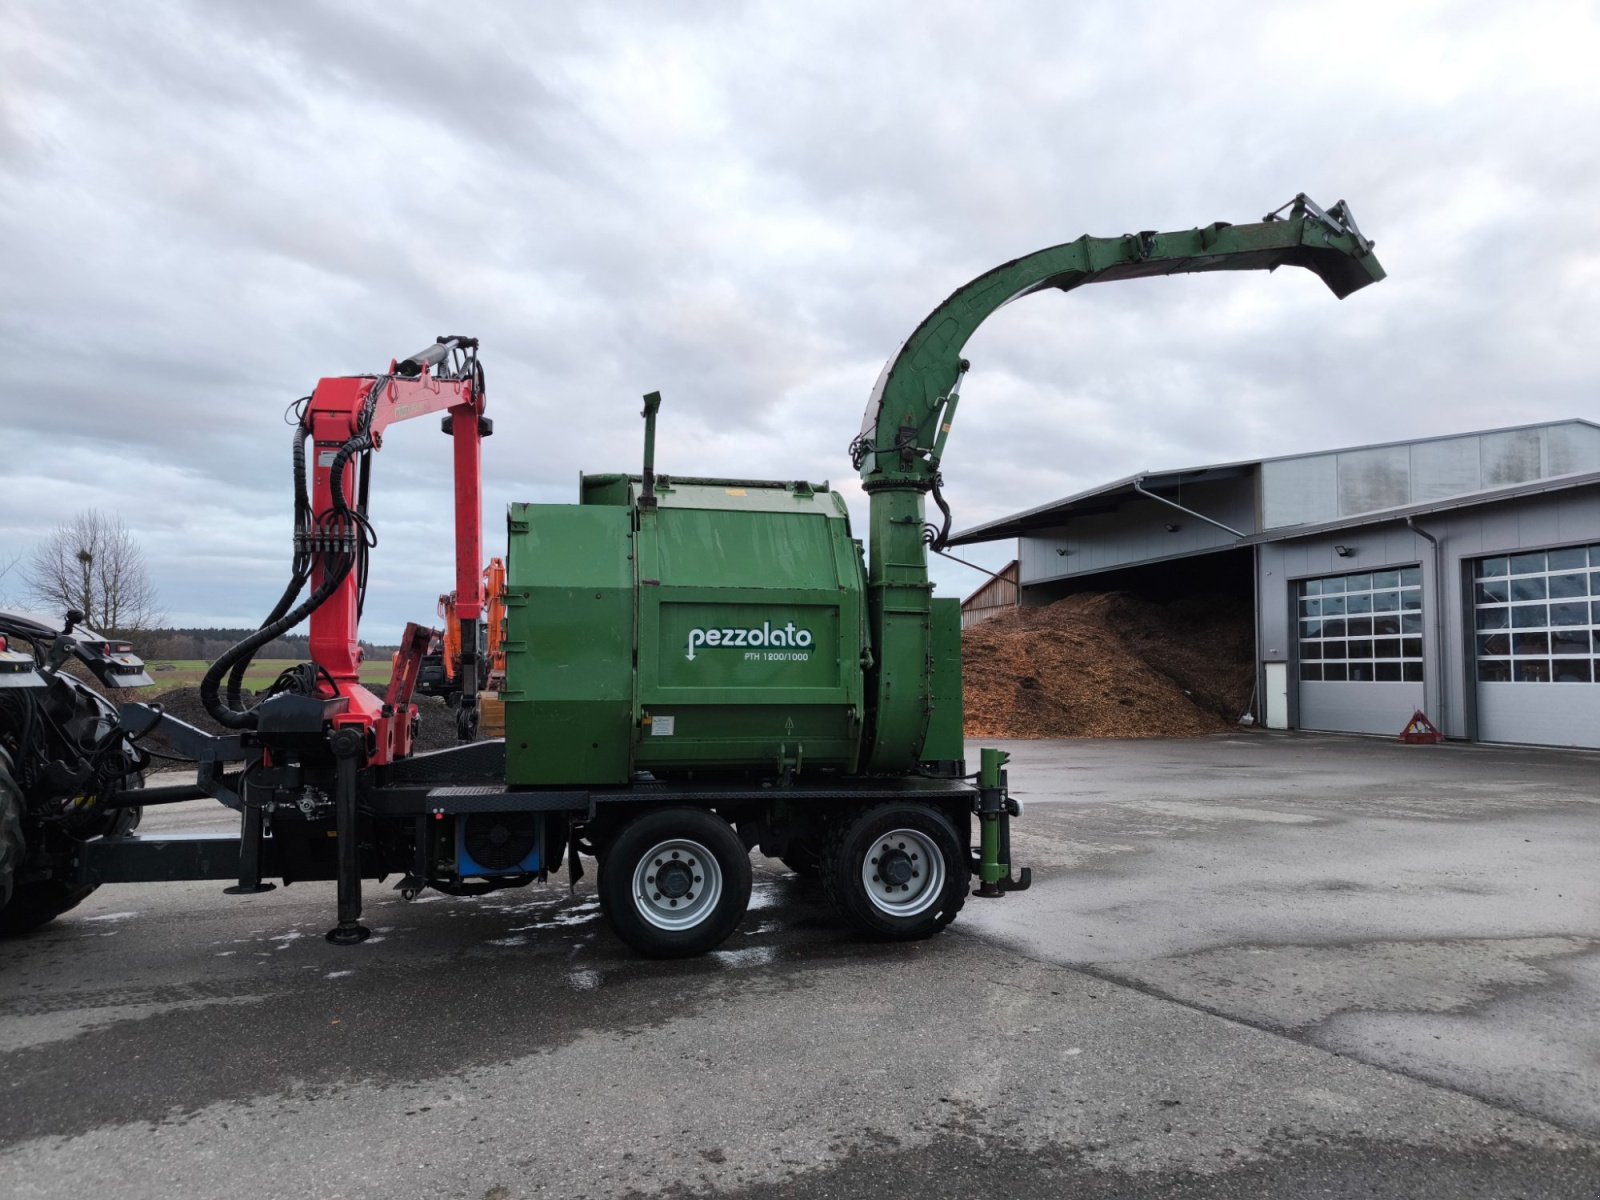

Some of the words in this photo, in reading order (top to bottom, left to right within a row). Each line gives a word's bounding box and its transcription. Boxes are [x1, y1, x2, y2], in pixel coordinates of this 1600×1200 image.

[685, 621, 812, 661] pezzolato
[744, 652, 760, 661] PTH
[763, 652, 809, 661] 1200/1000
